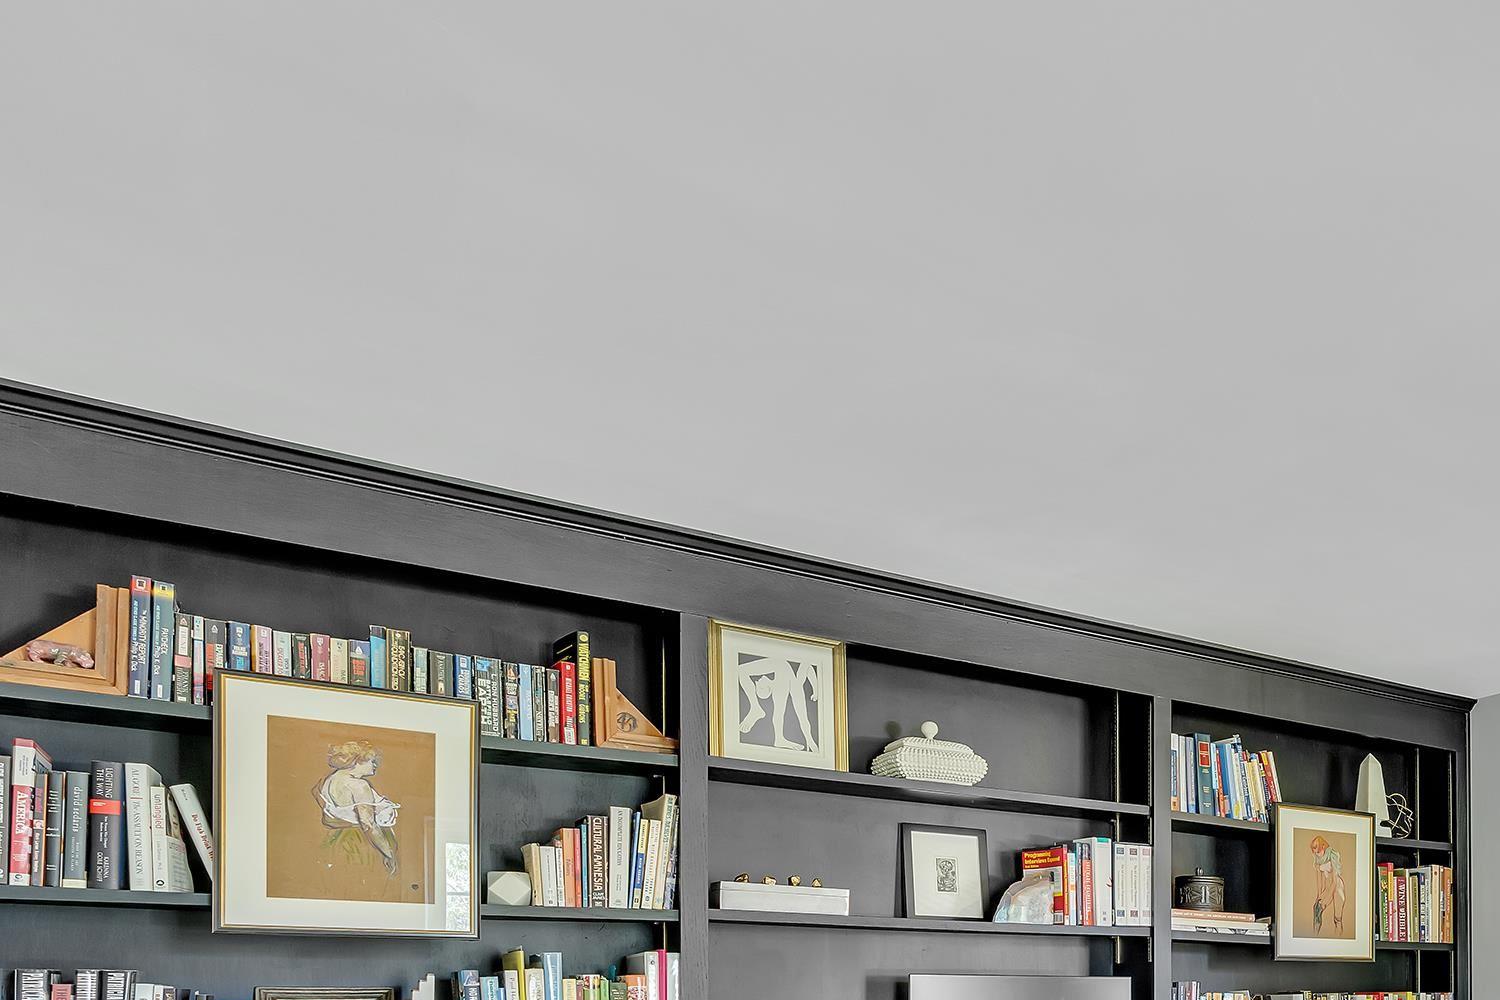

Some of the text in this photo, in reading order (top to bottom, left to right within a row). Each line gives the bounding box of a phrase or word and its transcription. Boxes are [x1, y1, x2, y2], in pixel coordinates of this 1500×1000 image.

[161, 628, 169, 655] PAYCHECK
[578, 643, 590, 681] WATCHMEN
[478, 678, 487, 725] EARTH
[96, 769, 104, 796] THE WAY
[105, 768, 113, 798] LIGHTING
[16, 791, 29, 834] AMERICA
[72, 787, 83, 832] david sedaris
[153, 794, 164, 829] untangled
[199, 835, 211, 850] Drink
[593, 818, 603, 891] CULTURAL AMNESIA
[1398, 884, 1406, 905] WINE
[22, 972, 43, 1000] PATRICIA
[56, 988, 67, 1000] THE
[107, 972, 125, 1000] PATRICIA
[469, 987, 478, 1000] HOW
